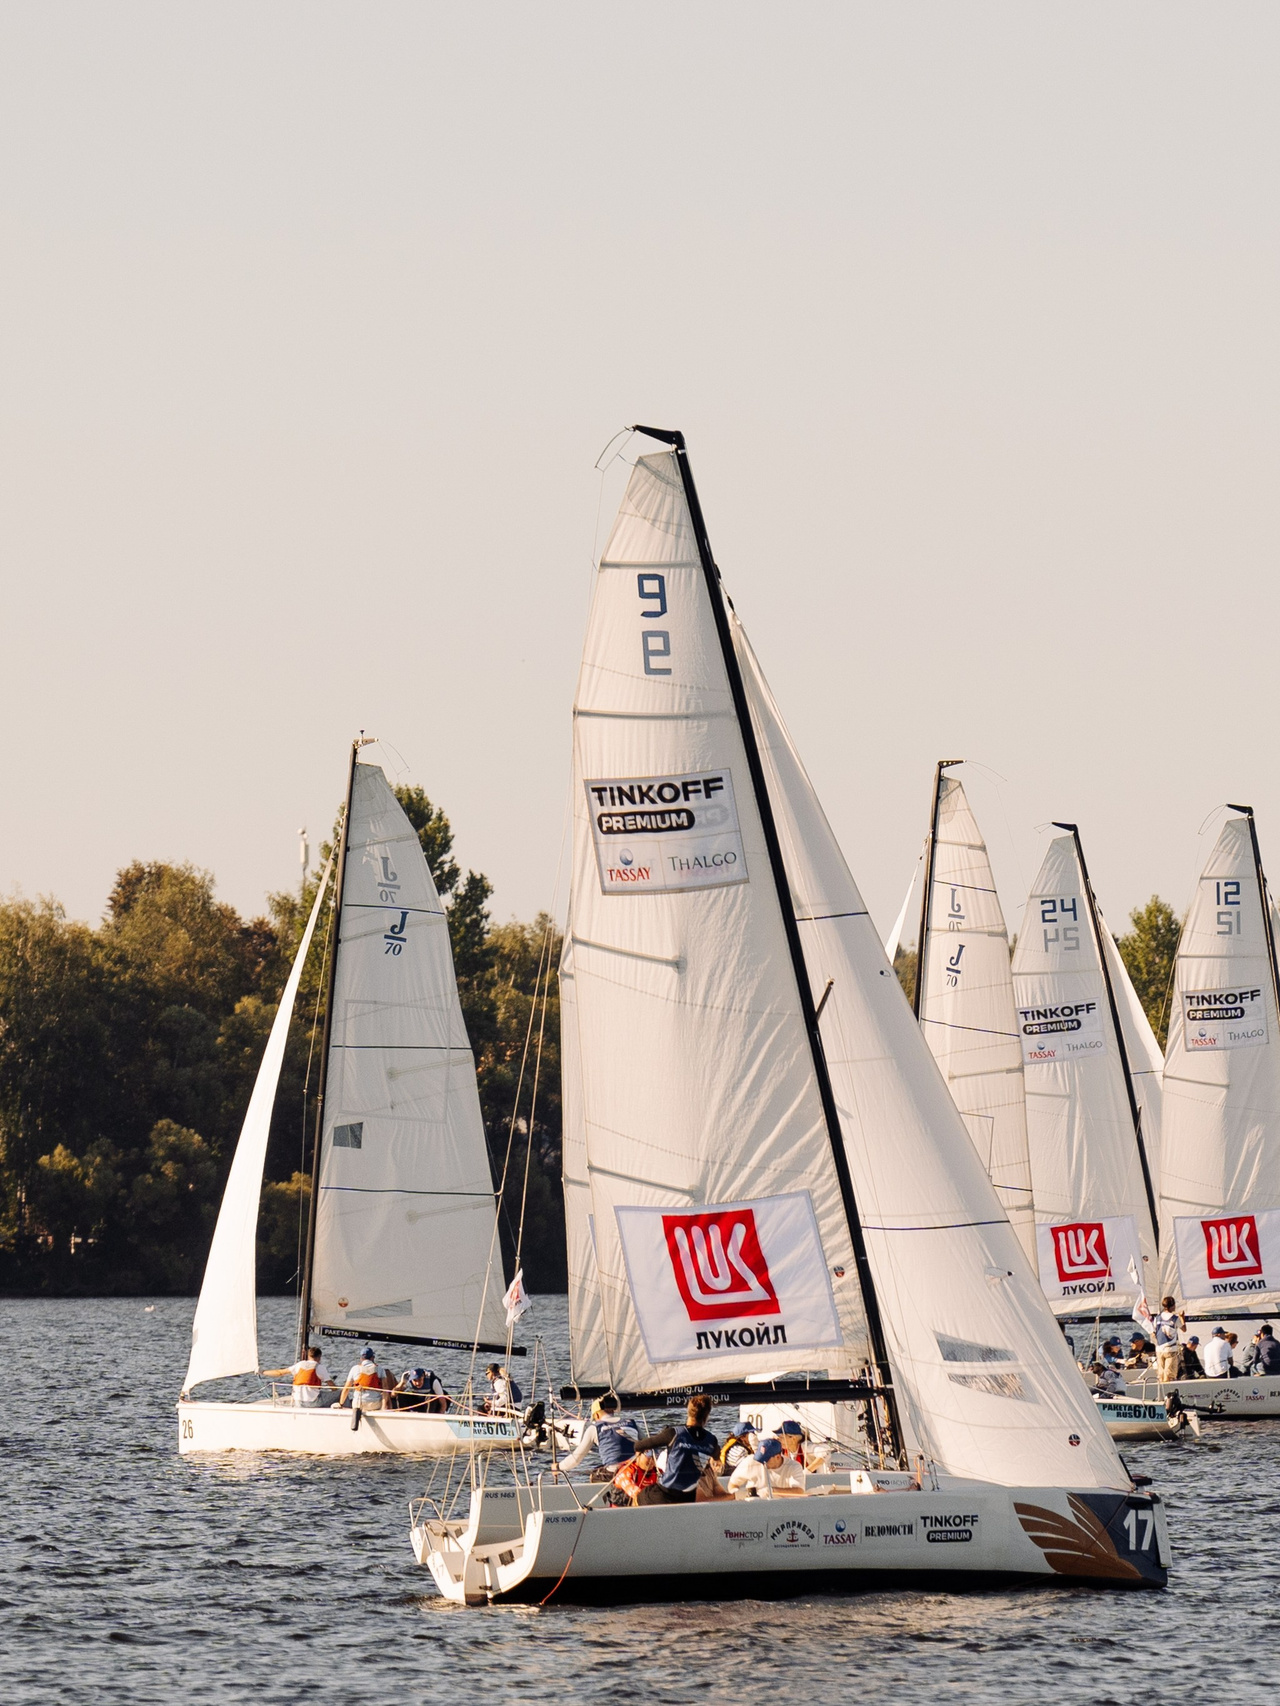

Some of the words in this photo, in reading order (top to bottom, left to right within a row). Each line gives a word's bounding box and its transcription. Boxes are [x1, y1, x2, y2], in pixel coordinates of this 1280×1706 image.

[637, 573, 667, 618] 9
[591, 777, 724, 806] TINKOFF
[601, 812, 689, 832] PREMIUM
[668, 851, 737, 871] THALGO
[607, 867, 650, 882] TASSAY
[1216, 881, 1241, 905] 12
[1041, 898, 1078, 923] 24
[390, 911, 409, 935] J
[385, 942, 402, 956] 70
[949, 944, 965, 966] J
[946, 974, 957, 987] 70
[1186, 989, 1261, 1006] TINKOFF
[1019, 1003, 1096, 1021] TINKOFF
[1189, 1009, 1242, 1019] PREMIUM
[1026, 1021, 1078, 1034] PREMIUM
[1227, 1029, 1264, 1040] THALGO
[1066, 1041, 1103, 1052] THALGO
[1191, 1038, 1217, 1046] TASSAY
[1028, 1050, 1056, 1059] TASSAY
[1062, 1281, 1115, 1296] ЛУКОЙЛ
[1212, 1278, 1266, 1294] ЛУКОЙЛ
[696, 1322, 787, 1350] ЛУКОЙЛ
[666, 1393, 730, 1406] pro-yang.ru
[1133, 1405, 1156, 1419] 670
[182, 1419, 194, 1439] 26
[486, 1422, 507, 1436] 670
[920, 1515, 979, 1528] TINKOFF
[770, 1521, 815, 1540] МОРПРИБОР
[865, 1524, 913, 1537] ВЕДОМОСТИ
[929, 1532, 970, 1541] PREMIUM
[1123, 1509, 1154, 1550] 17
[823, 1534, 857, 1545] TASSAY
